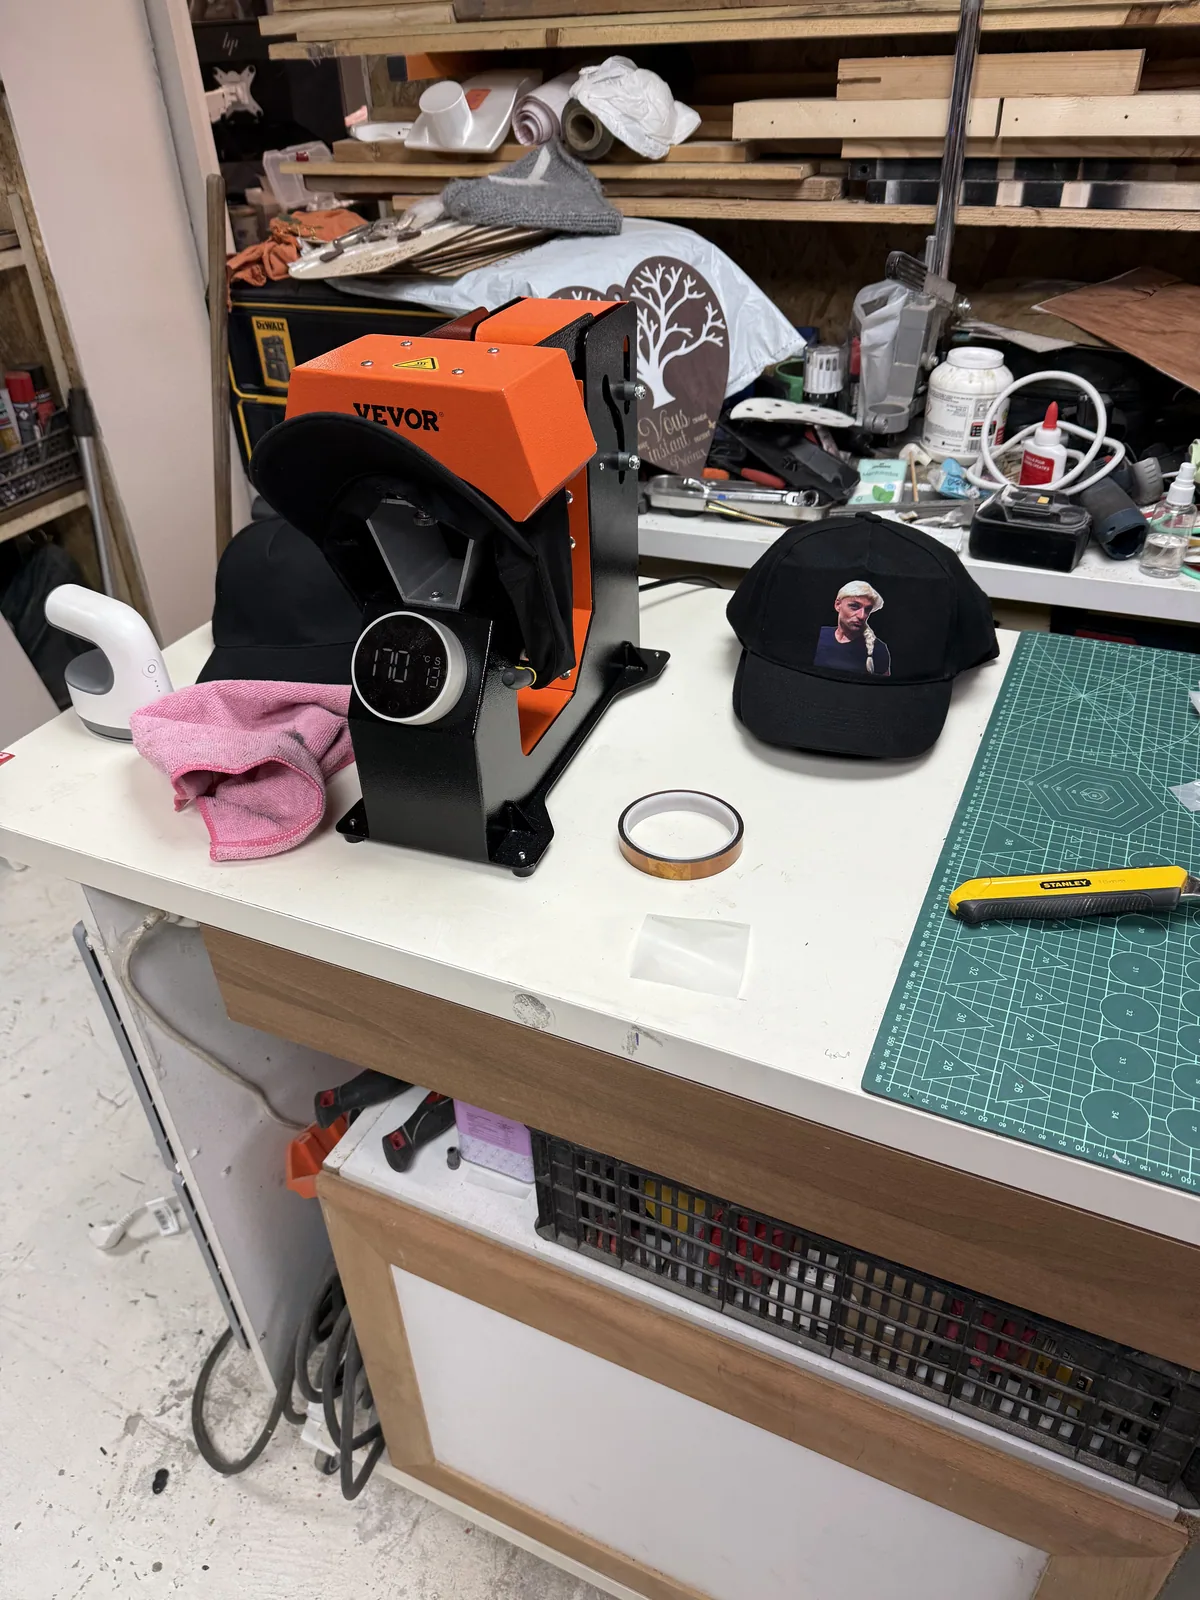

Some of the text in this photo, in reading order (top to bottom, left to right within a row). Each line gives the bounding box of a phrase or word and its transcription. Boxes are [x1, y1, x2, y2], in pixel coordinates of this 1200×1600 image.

[353, 402, 439, 432] VEVOR
[637, 409, 691, 442] Vous
[649, 430, 691, 462] instant
[372, 647, 410, 683] 170
[1043, 880, 1087, 889] STANLEY
[922, 930, 930, 938] 450
[968, 966, 979, 976] 32
[905, 980, 914, 989] 500
[1035, 992, 1043, 1001] 22
[956, 1012, 967, 1023] 30
[886, 1035, 895, 1046] 550
[1026, 1032, 1035, 1042] 24
[942, 1060, 954, 1072] 28
[1118, 1056, 1127, 1065] 33
[1013, 1082, 1024, 1094] 26
[1111, 1110, 1120, 1119] 34
[921, 1097, 930, 1105] 20
[977, 1115, 989, 1123] 50
[1018, 1127, 1026, 1135] 70
[1075, 1144, 1090, 1154] 100
[1097, 1151, 1109, 1159] 110
[1118, 1158, 1131, 1166] 120
[1139, 1164, 1152, 1172] 130
[1160, 1170, 1173, 1178] 140
[1180, 1176, 1197, 1186] 150
